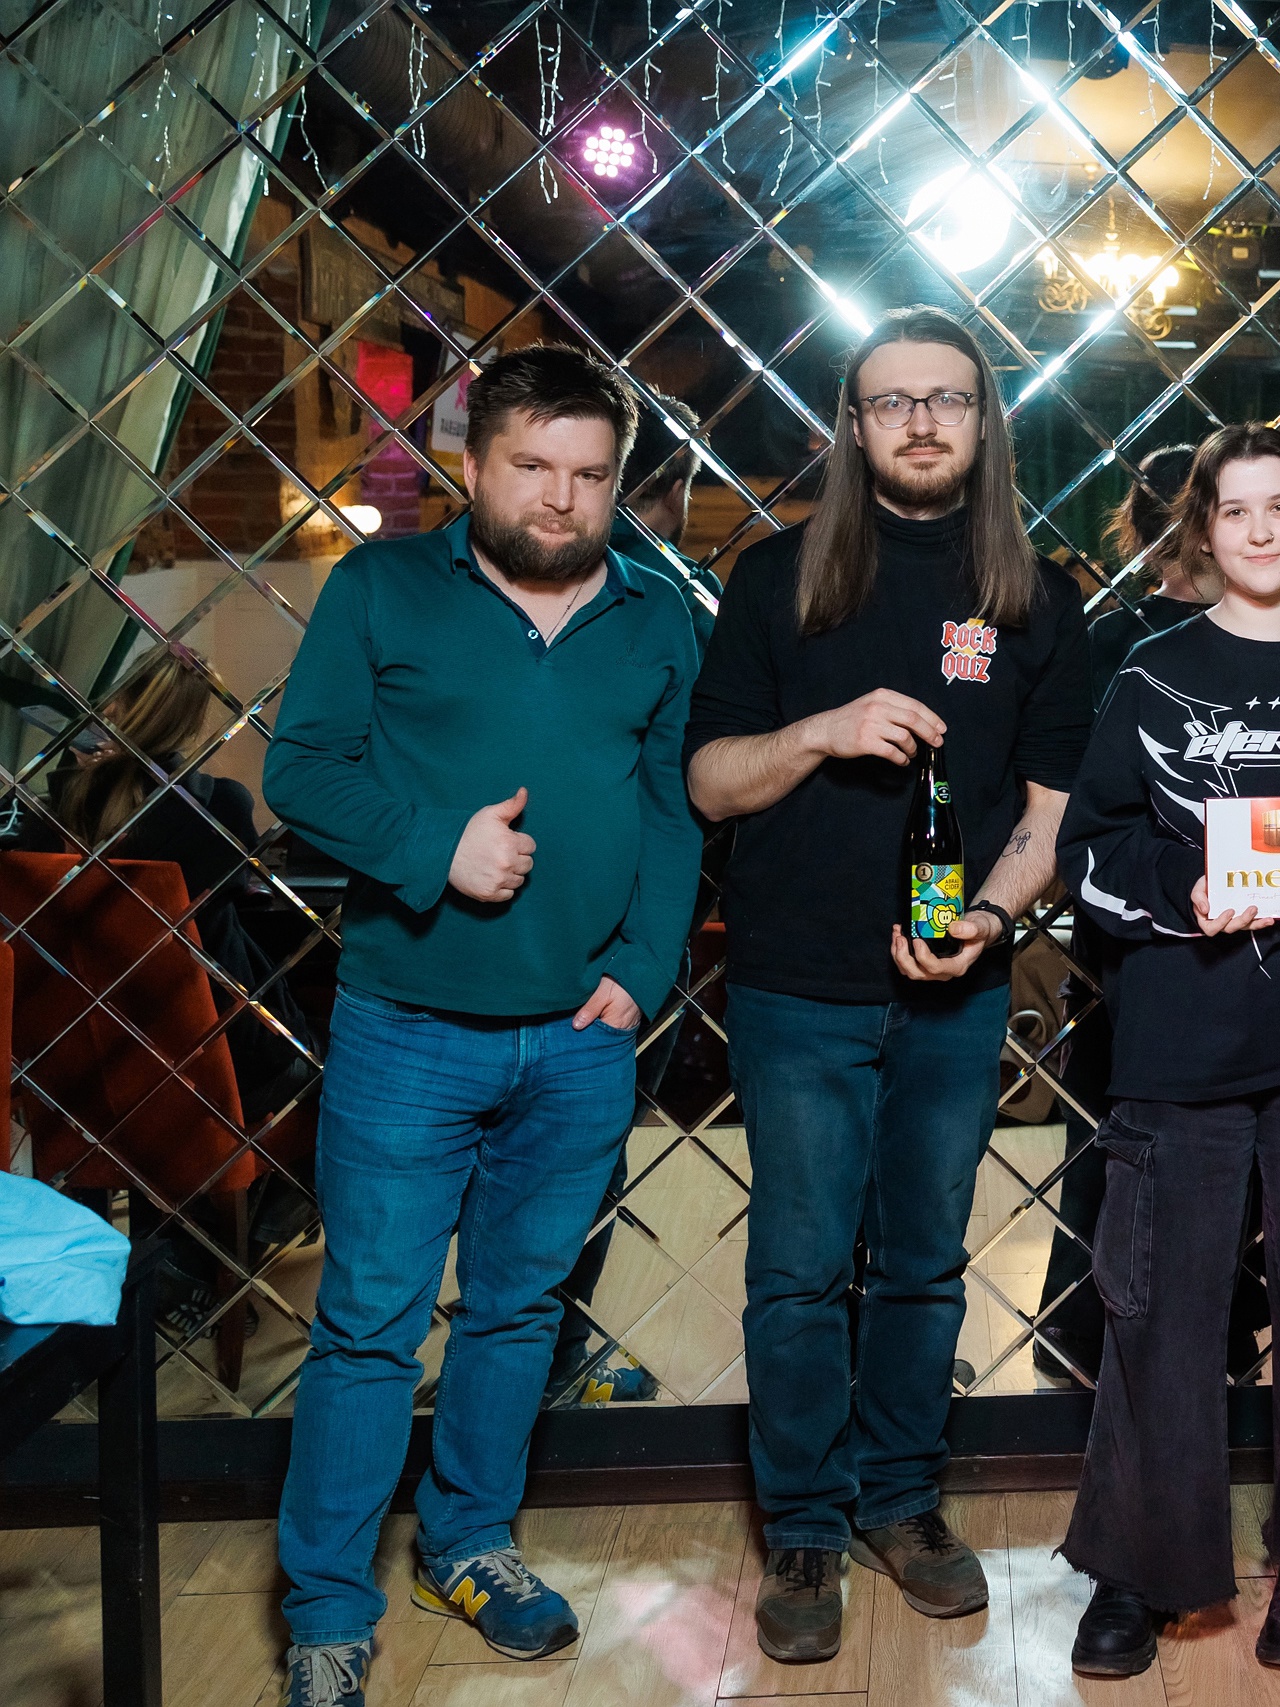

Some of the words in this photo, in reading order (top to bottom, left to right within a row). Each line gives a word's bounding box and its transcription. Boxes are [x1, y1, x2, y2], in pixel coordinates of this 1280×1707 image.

[941, 621, 997, 654] ROCK
[942, 652, 991, 683] QUIZ
[449, 1576, 491, 1620] N
